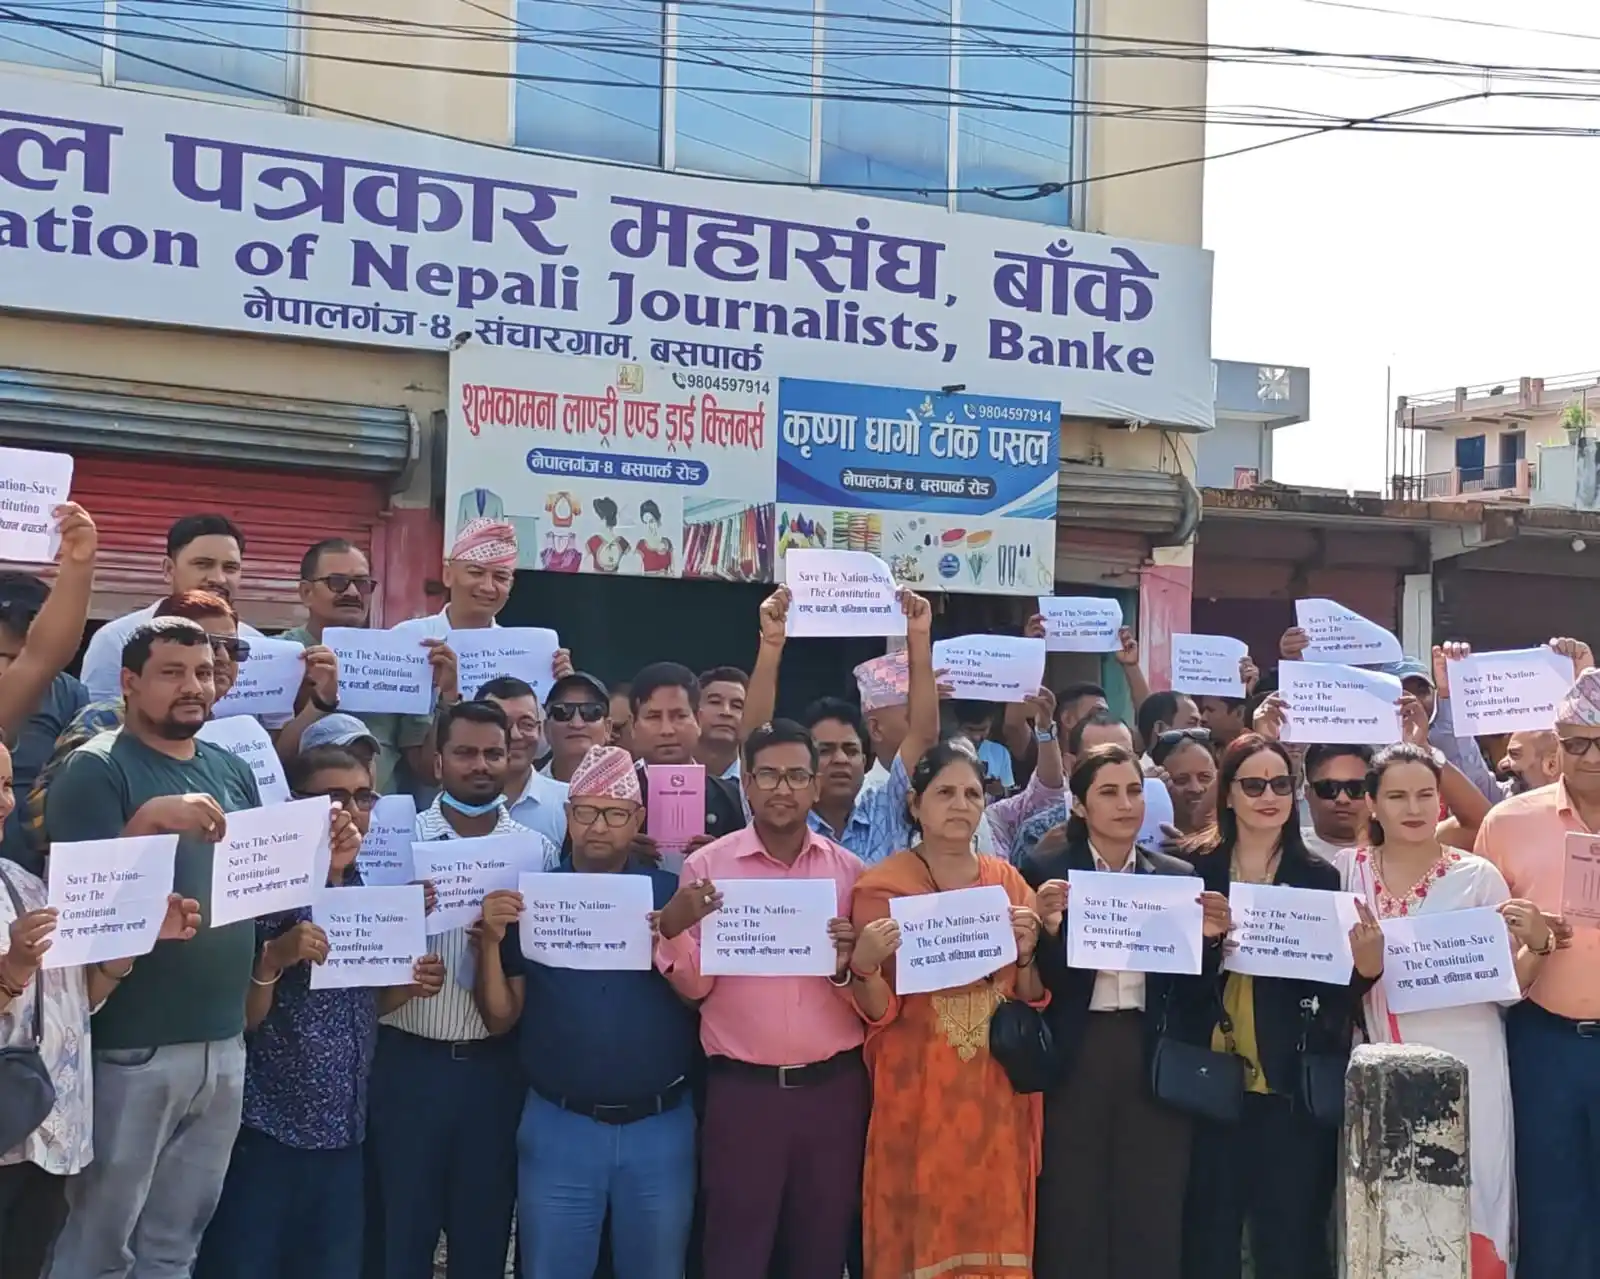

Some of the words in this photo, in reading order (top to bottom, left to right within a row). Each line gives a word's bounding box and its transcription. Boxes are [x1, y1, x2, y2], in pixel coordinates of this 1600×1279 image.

[165, 133, 577, 255] पत्रकार
[993, 238, 1159, 324] बाँके
[235, 233, 319, 280] of
[351, 239, 579, 311] Nepali
[608, 271, 960, 363] Journalists,
[989, 319, 1155, 376] Banke
[475, 316, 637, 361] संचारग्राम,
[650, 338, 765, 371] बसपार्क
[688, 374, 770, 395] 9804597914
[462, 383, 559, 436] शुभकामना
[623, 400, 661, 439] एण्ड
[979, 404, 1052, 424] 9804597914
[783, 409, 858, 460] कृष्णा
[988, 427, 1052, 466] पसल
[620, 461, 672, 478] बसपार्क
[676, 462, 701, 481] रोड
[920, 478, 966, 494] बसपार्क
[968, 480, 990, 495] रोड
[798, 571, 820, 583] Save
[822, 571, 837, 583] The
[810, 588, 826, 598] The
[827, 588, 881, 600] Constitution
[334, 648, 353, 659] Save
[356, 649, 372, 660] The
[344, 664, 360, 675] The
[361, 665, 413, 678] Constitution
[1292, 681, 1313, 689] Save
[1316, 681, 1333, 689] The
[1462, 676, 1483, 684] Save
[1486, 674, 1503, 682] The
[1292, 693, 1313, 701] Save
[1316, 693, 1333, 701] The
[1464, 688, 1485, 696] Save
[1487, 686, 1504, 694] The
[1292, 704, 1347, 713] Constitution
[1465, 697, 1520, 708] Constitution
[229, 840, 251, 851] Save
[252, 837, 269, 847] The
[228, 857, 250, 867] Save
[252, 853, 268, 863] The
[431, 863, 453, 873] Save
[456, 862, 473, 871] The
[66, 874, 88, 885] Save
[91, 872, 108, 883] The
[227, 867, 280, 883] Constitution
[432, 877, 453, 885] Save
[456, 876, 472, 884] The
[65, 892, 86, 902] Save
[89, 890, 105, 900] The
[437, 888, 485, 898] onstitution
[533, 901, 556, 911] Save
[559, 901, 577, 910] The
[1084, 896, 1108, 907] Save
[1110, 898, 1129, 909] The
[61, 907, 117, 920] Constitution
[717, 905, 740, 914] Save
[743, 905, 761, 914] The
[1244, 908, 1268, 918] Save
[1270, 910, 1287, 919] The
[330, 914, 352, 923] Save
[354, 914, 373, 923] The
[533, 914, 556, 923] Save
[559, 914, 577, 923] The
[1083, 911, 1107, 921] Save
[1110, 913, 1128, 922] The
[717, 919, 739, 928] Save
[743, 919, 760, 928] The
[903, 922, 924, 933] Save
[927, 919, 943, 930] The
[1242, 921, 1266, 930] Save
[1268, 922, 1285, 931] The
[329, 928, 352, 937] Save
[355, 928, 372, 937] The
[533, 927, 592, 937] Constitution
[717, 932, 776, 942] Constitution
[1083, 924, 1142, 938] Constitution
[916, 938, 933, 949] The
[934, 930, 990, 946] Constitution
[1241, 933, 1300, 945] Constitution
[329, 942, 383, 952] Constitution
[1387, 944, 1410, 955] Save
[1413, 942, 1431, 953] The
[1403, 959, 1423, 971] The
[1424, 953, 1484, 970] Constitution
